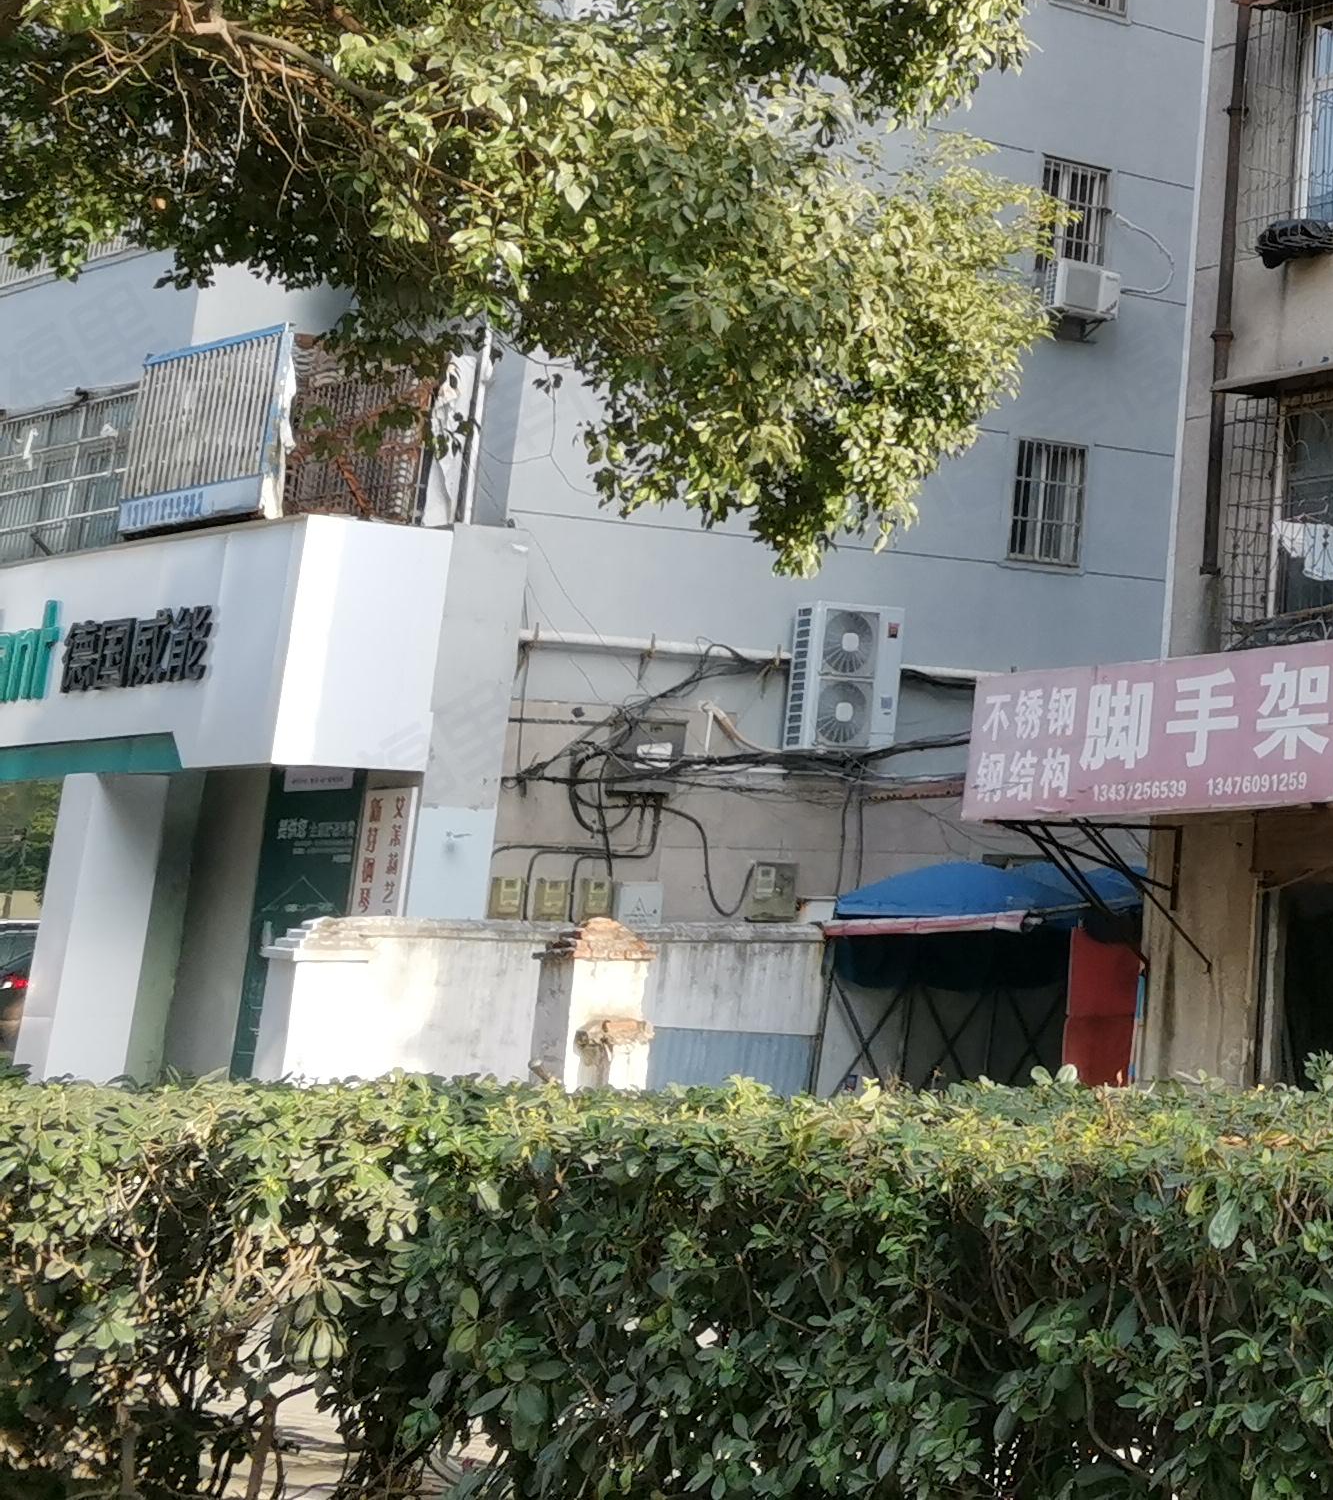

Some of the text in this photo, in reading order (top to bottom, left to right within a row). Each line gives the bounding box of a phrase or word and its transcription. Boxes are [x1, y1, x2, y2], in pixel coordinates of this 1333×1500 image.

[60, 604, 213, 693] 德国威能
[982, 686, 1077, 742] 不锈钢
[1080, 661, 1330, 770] 脚手架
[976, 746, 1070, 804] 钢结构
[1206, 771, 1308, 797] 13476091259
